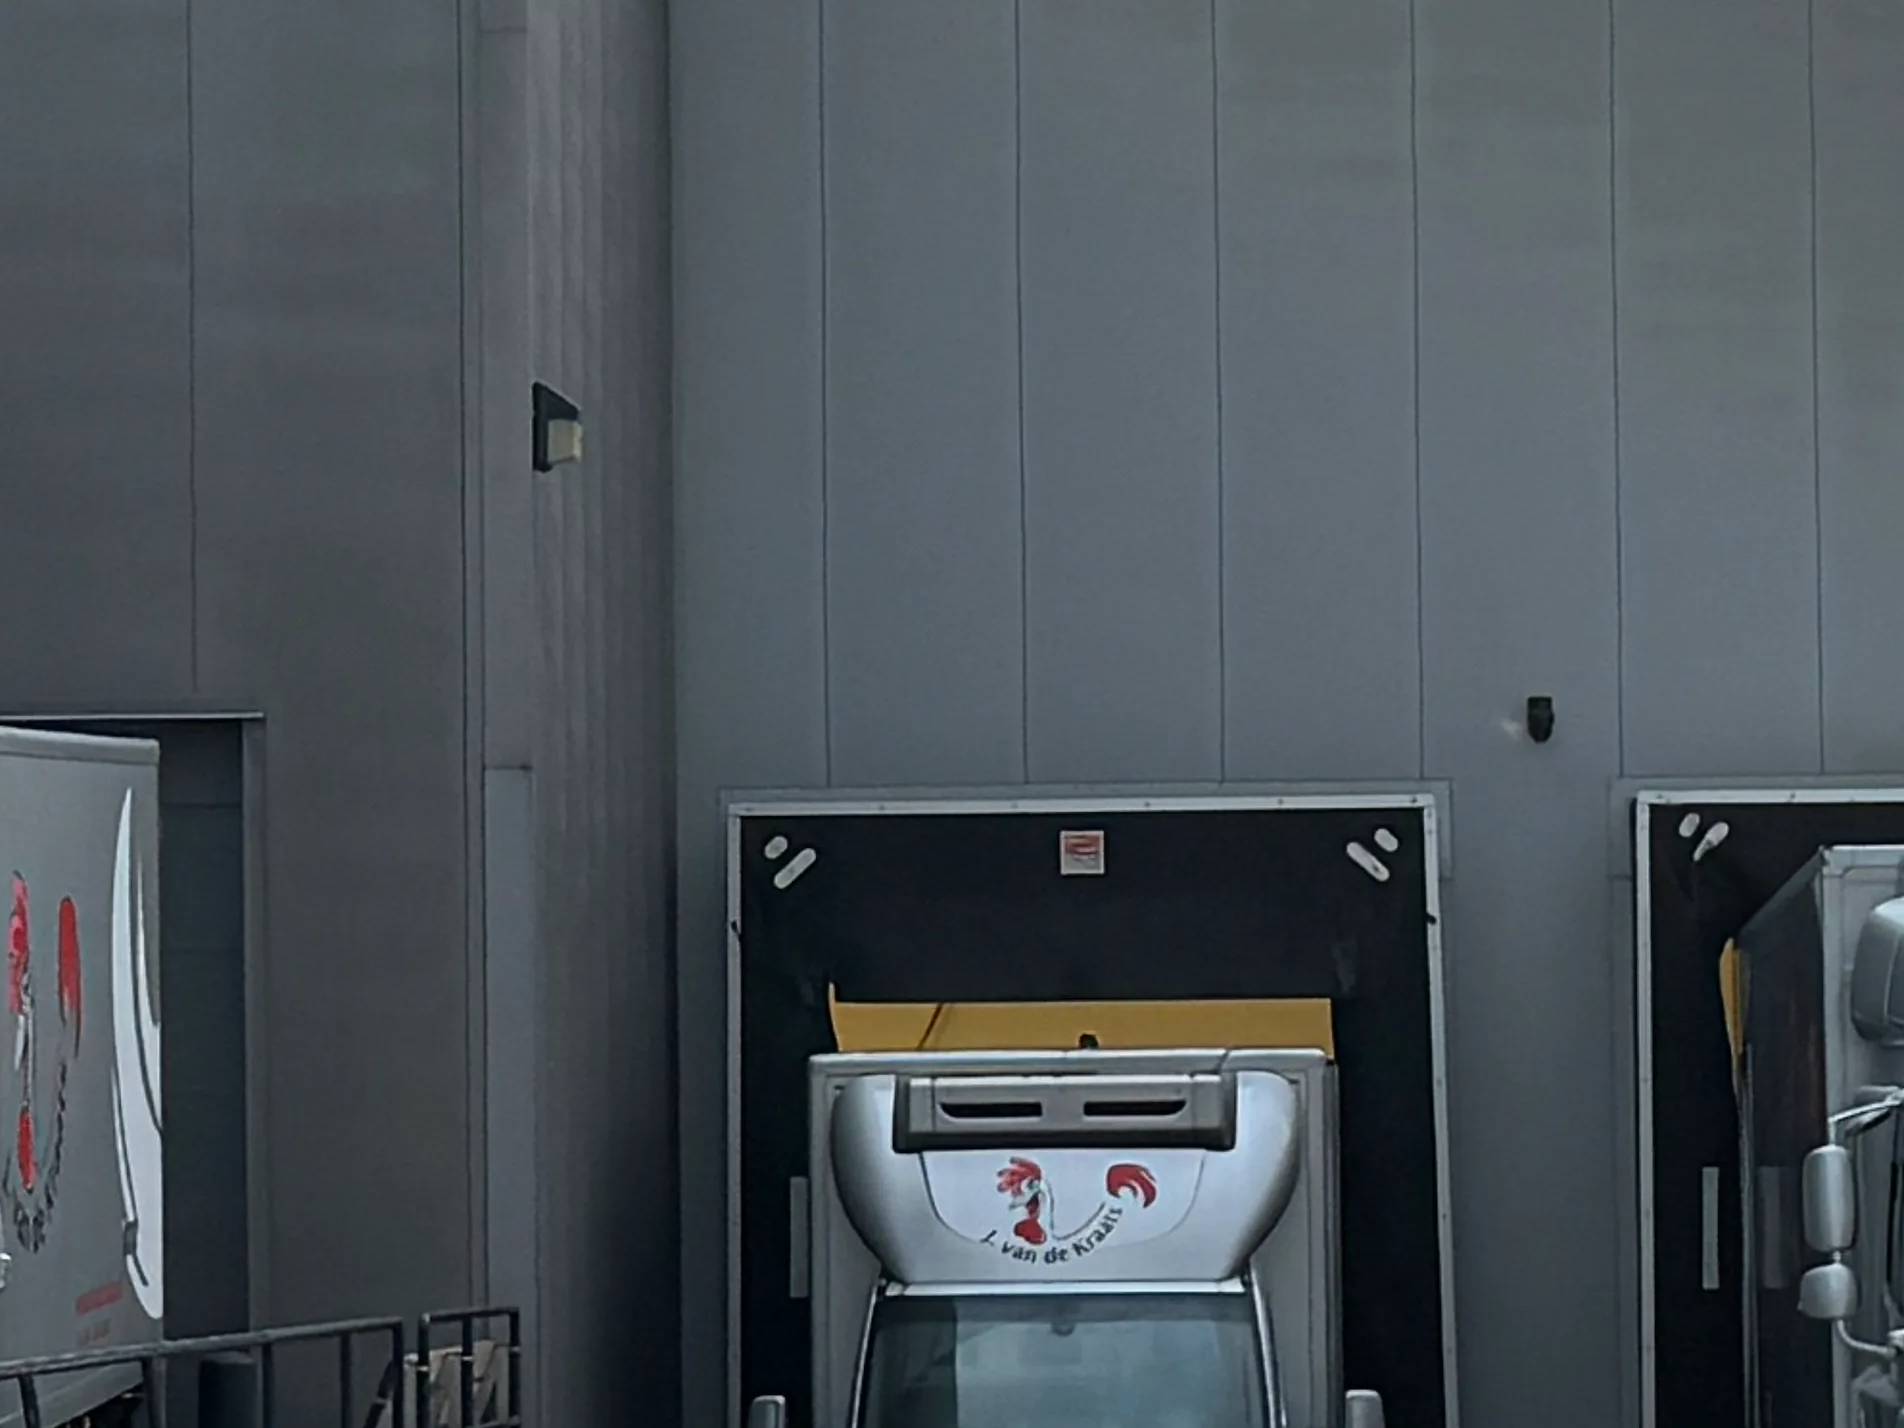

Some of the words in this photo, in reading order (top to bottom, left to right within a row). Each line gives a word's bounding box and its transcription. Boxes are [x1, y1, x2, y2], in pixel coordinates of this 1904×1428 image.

[1001, 1241, 1037, 1264] van
[1043, 1247, 1070, 1265] de
[1072, 1207, 1124, 1258] Kraats
